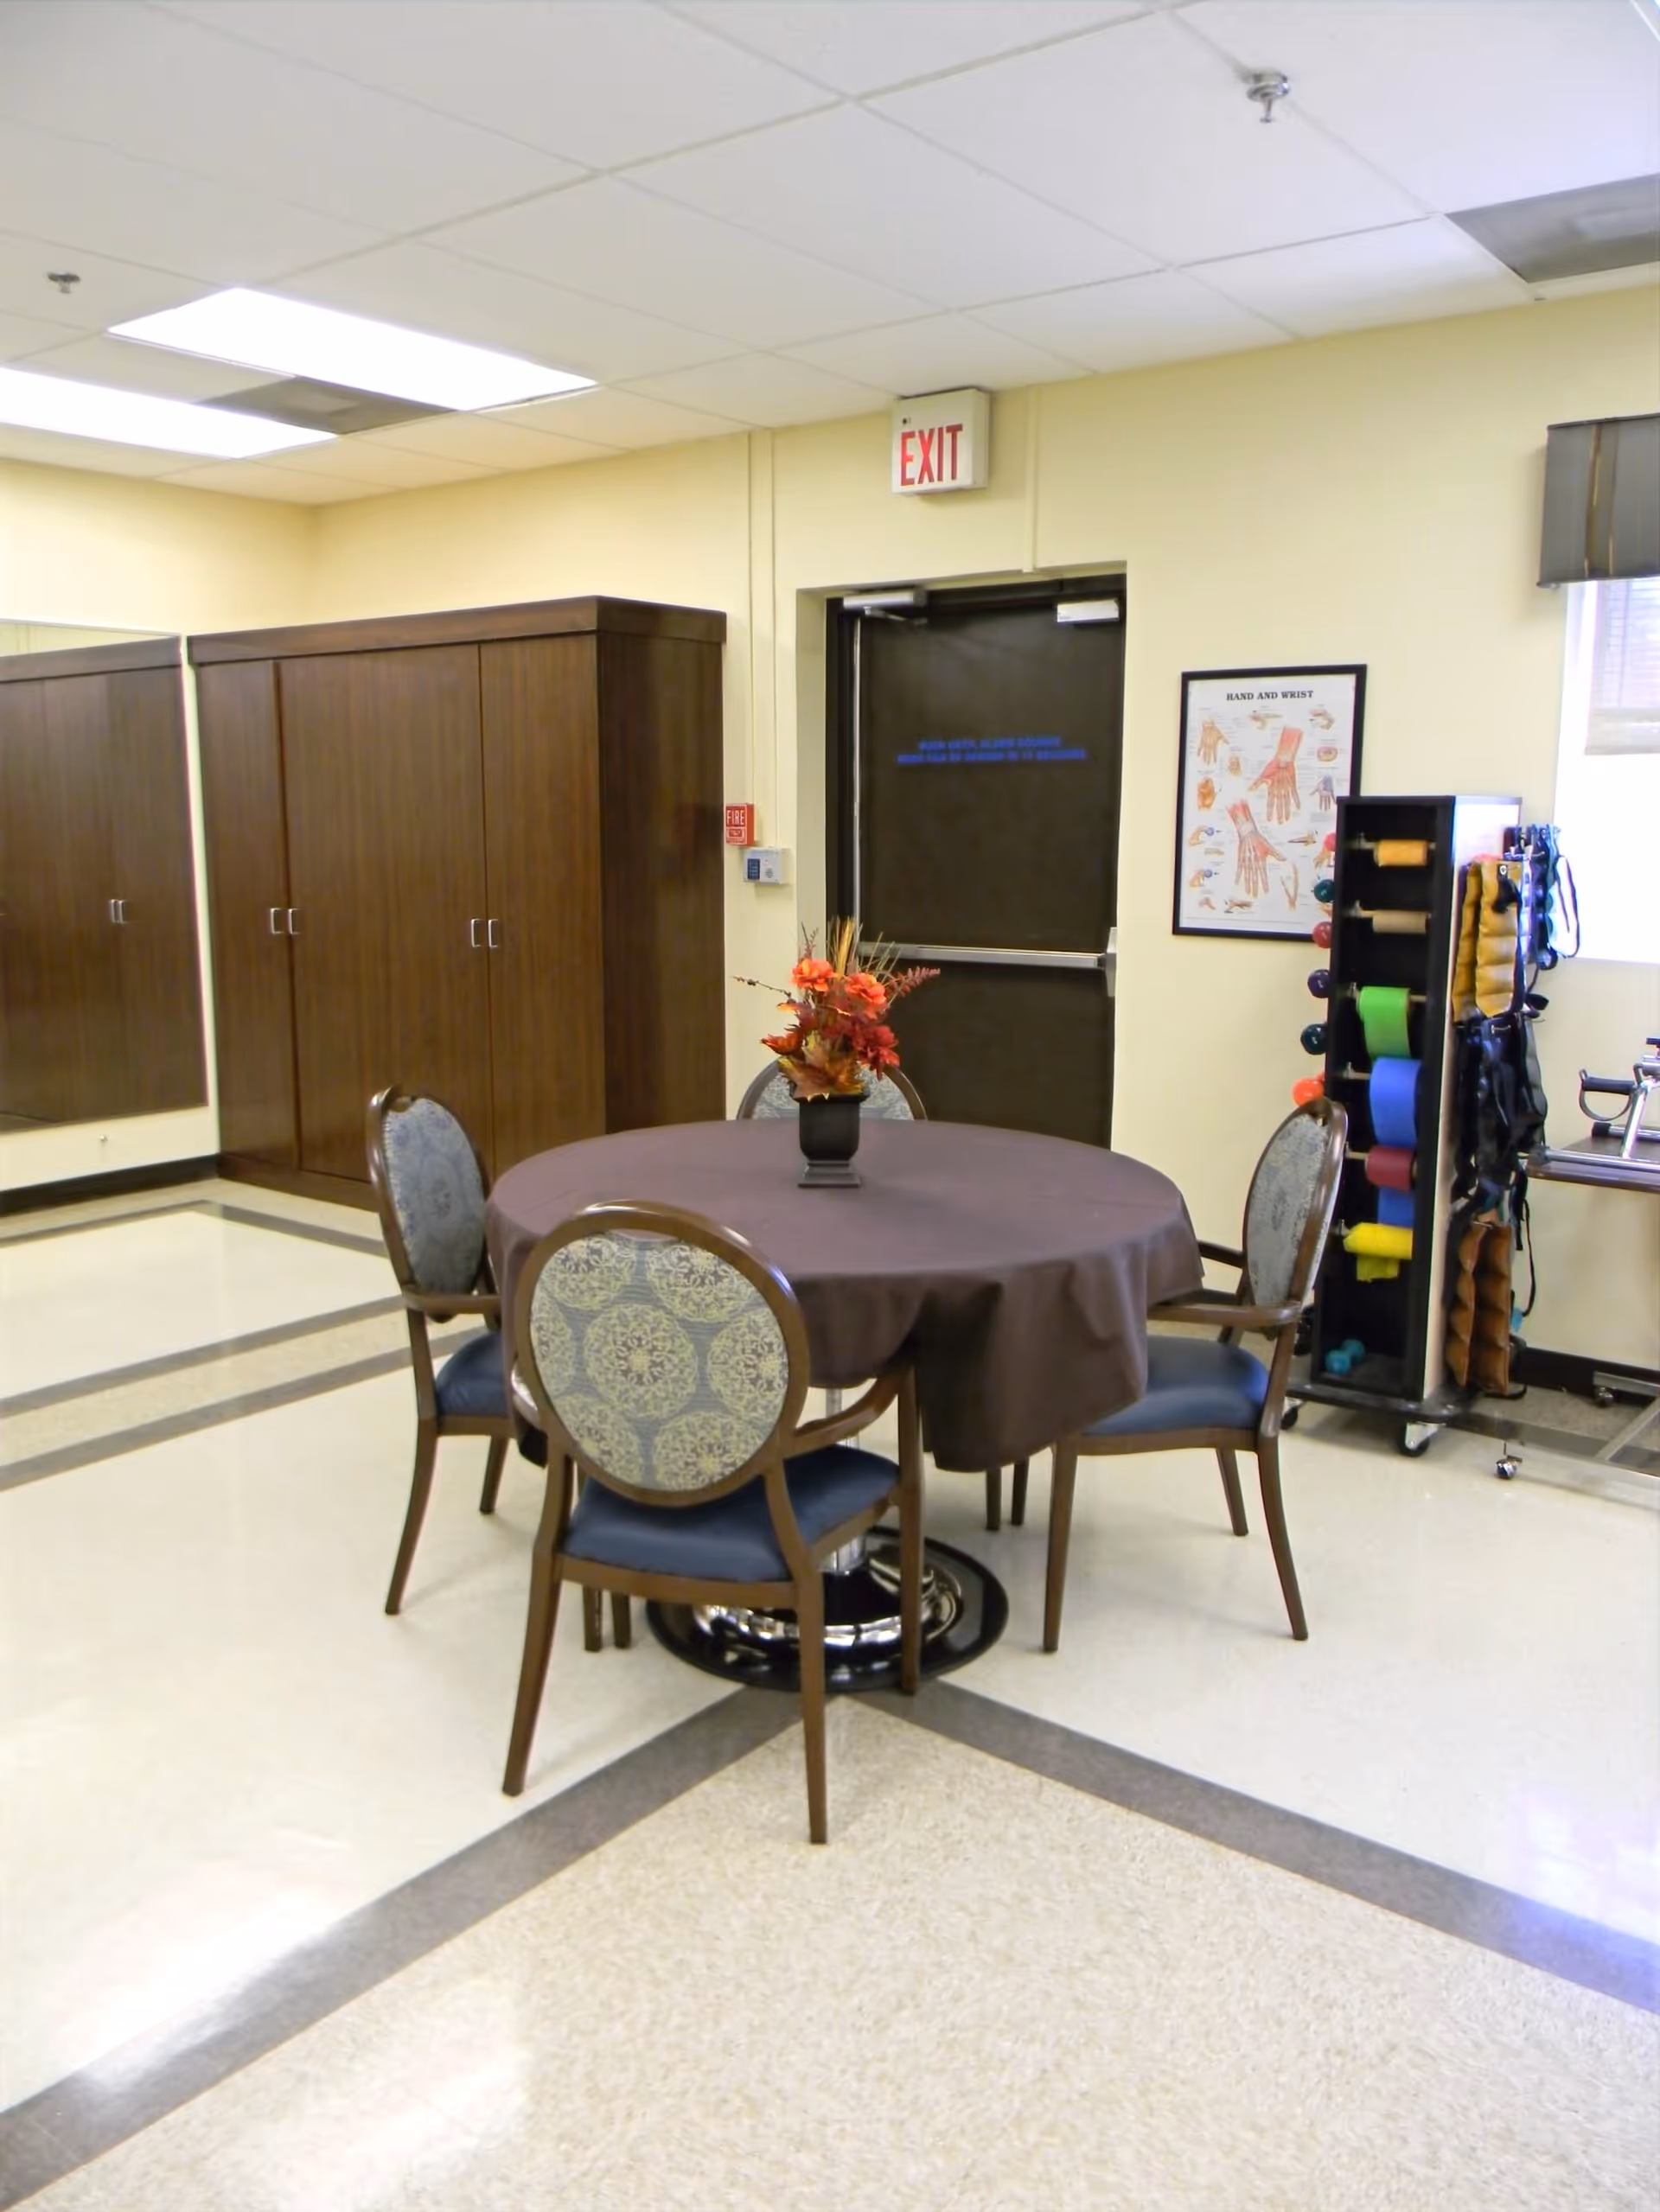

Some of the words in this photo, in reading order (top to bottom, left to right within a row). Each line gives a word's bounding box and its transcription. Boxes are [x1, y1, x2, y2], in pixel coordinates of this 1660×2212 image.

[901, 424, 963, 487] EXIT
[1226, 692, 1254, 701] HAND
[1257, 692, 1278, 700] AND
[1281, 690, 1313, 698] WRIST
[727, 810, 744, 825] FIRE
